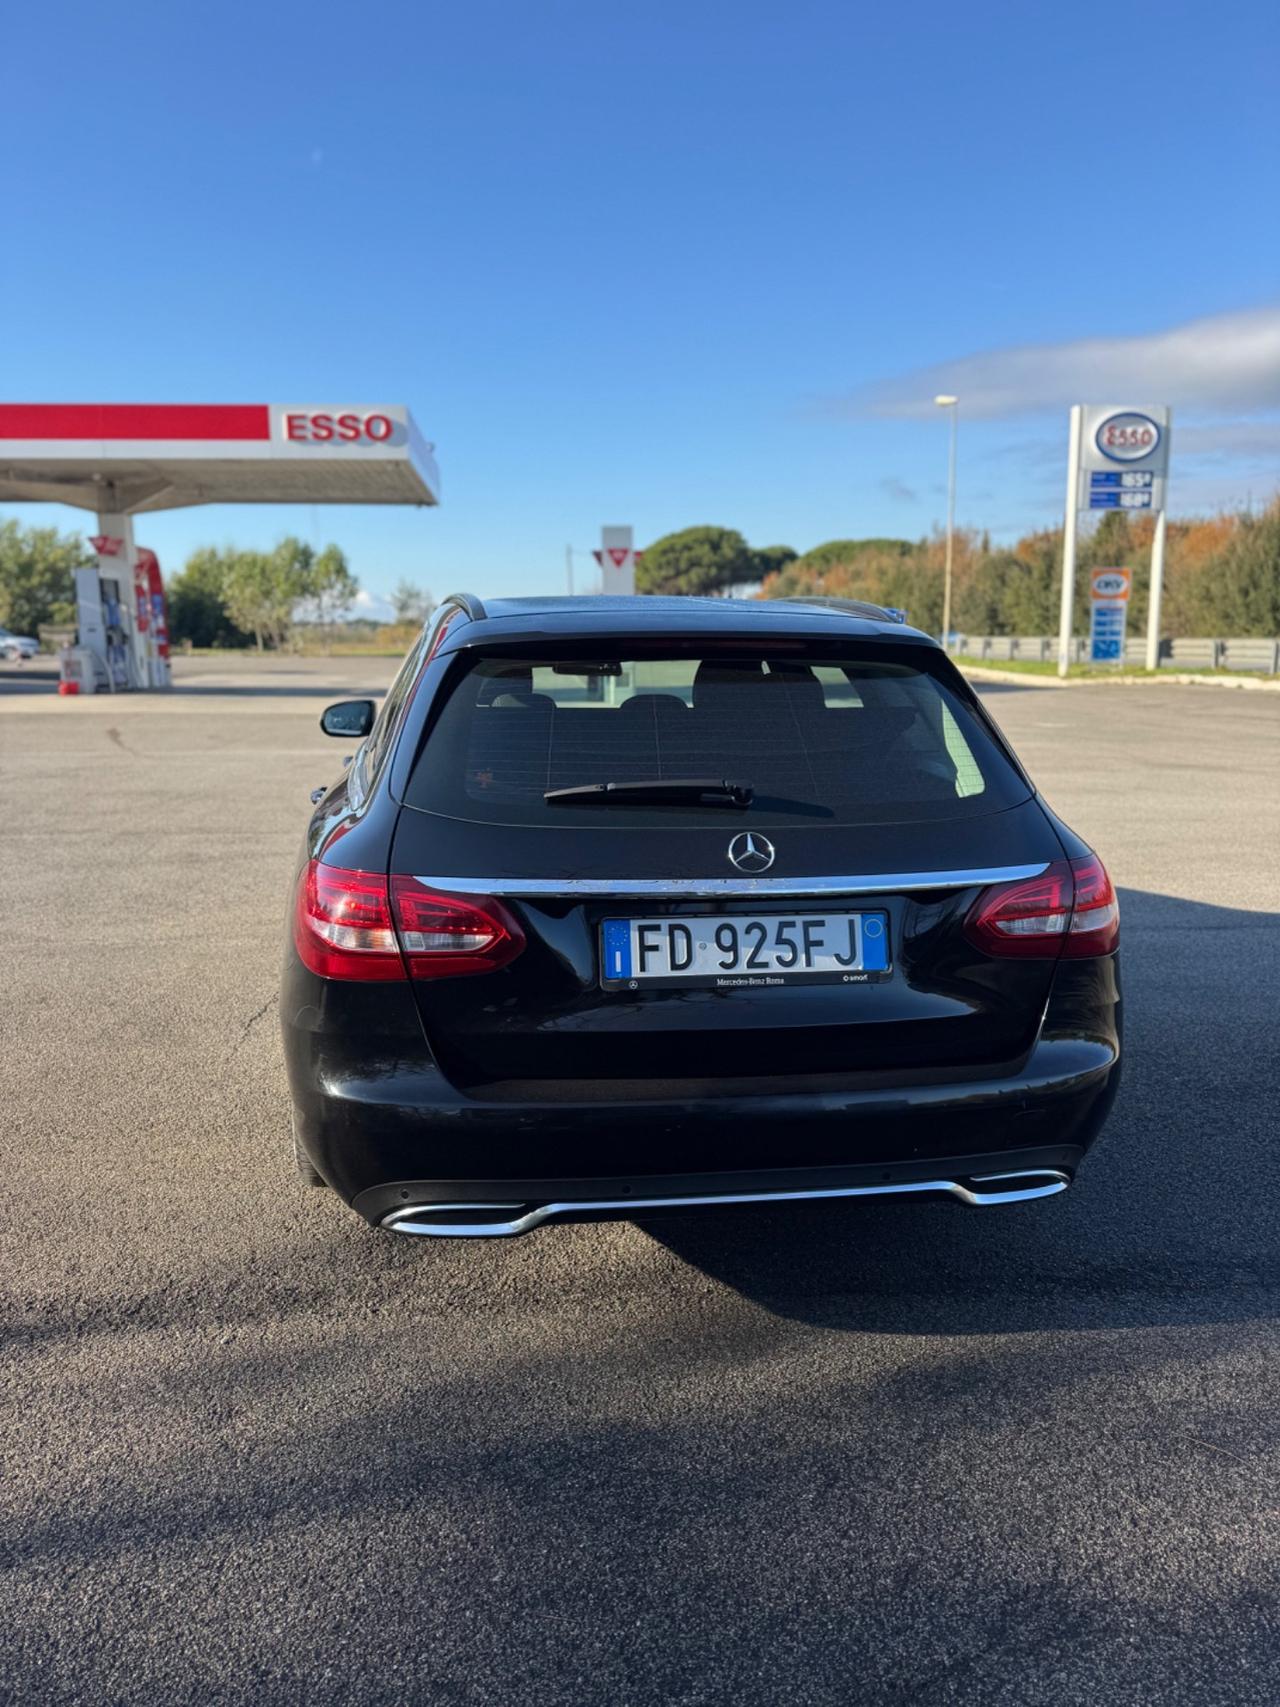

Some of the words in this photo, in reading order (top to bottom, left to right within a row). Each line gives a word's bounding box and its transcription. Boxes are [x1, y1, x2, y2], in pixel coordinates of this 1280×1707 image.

[285, 414, 393, 442] ESSO
[637, 923, 692, 972] FD
[714, 918, 858, 970] 925FJ
[716, 977, 765, 987] Mercedes-Benz
